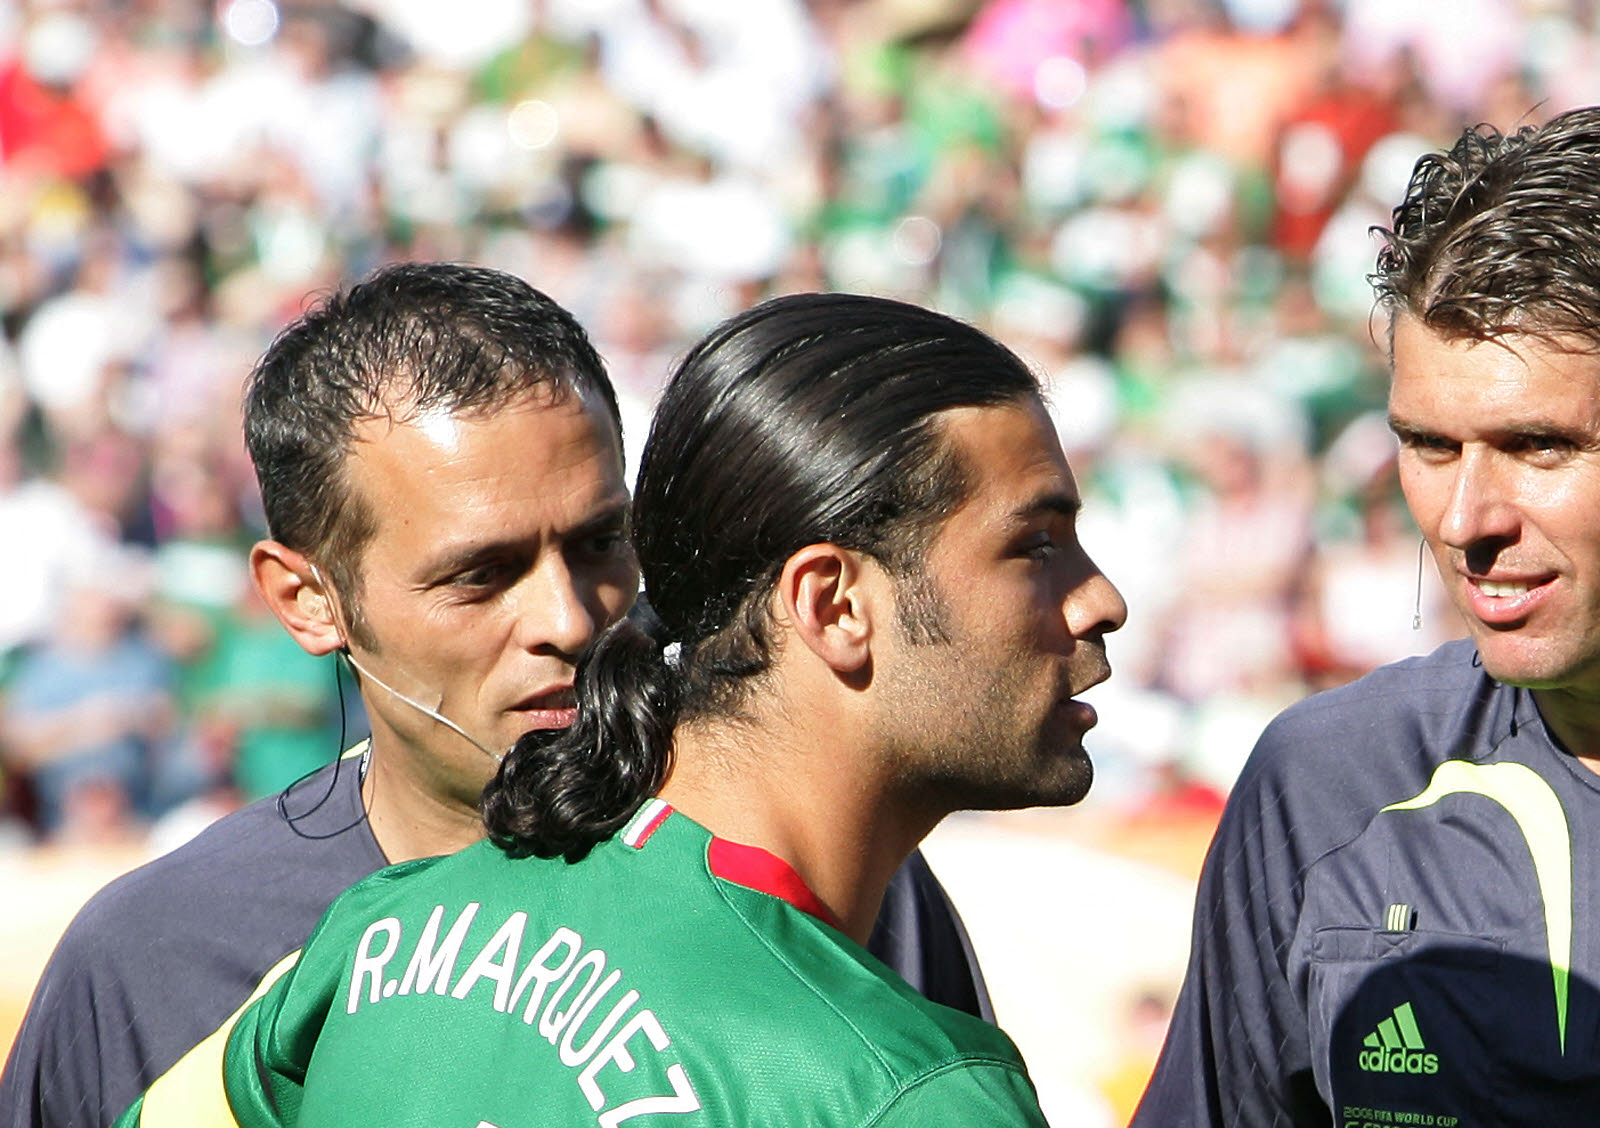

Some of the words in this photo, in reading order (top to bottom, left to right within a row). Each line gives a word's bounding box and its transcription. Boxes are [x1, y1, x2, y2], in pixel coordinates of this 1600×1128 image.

[1359, 1046, 1439, 1075] adidas
[1374, 1110, 1393, 1122] FIFA
[1394, 1111, 1435, 1126] WORLD
[1436, 1115, 1459, 1127] CUP
